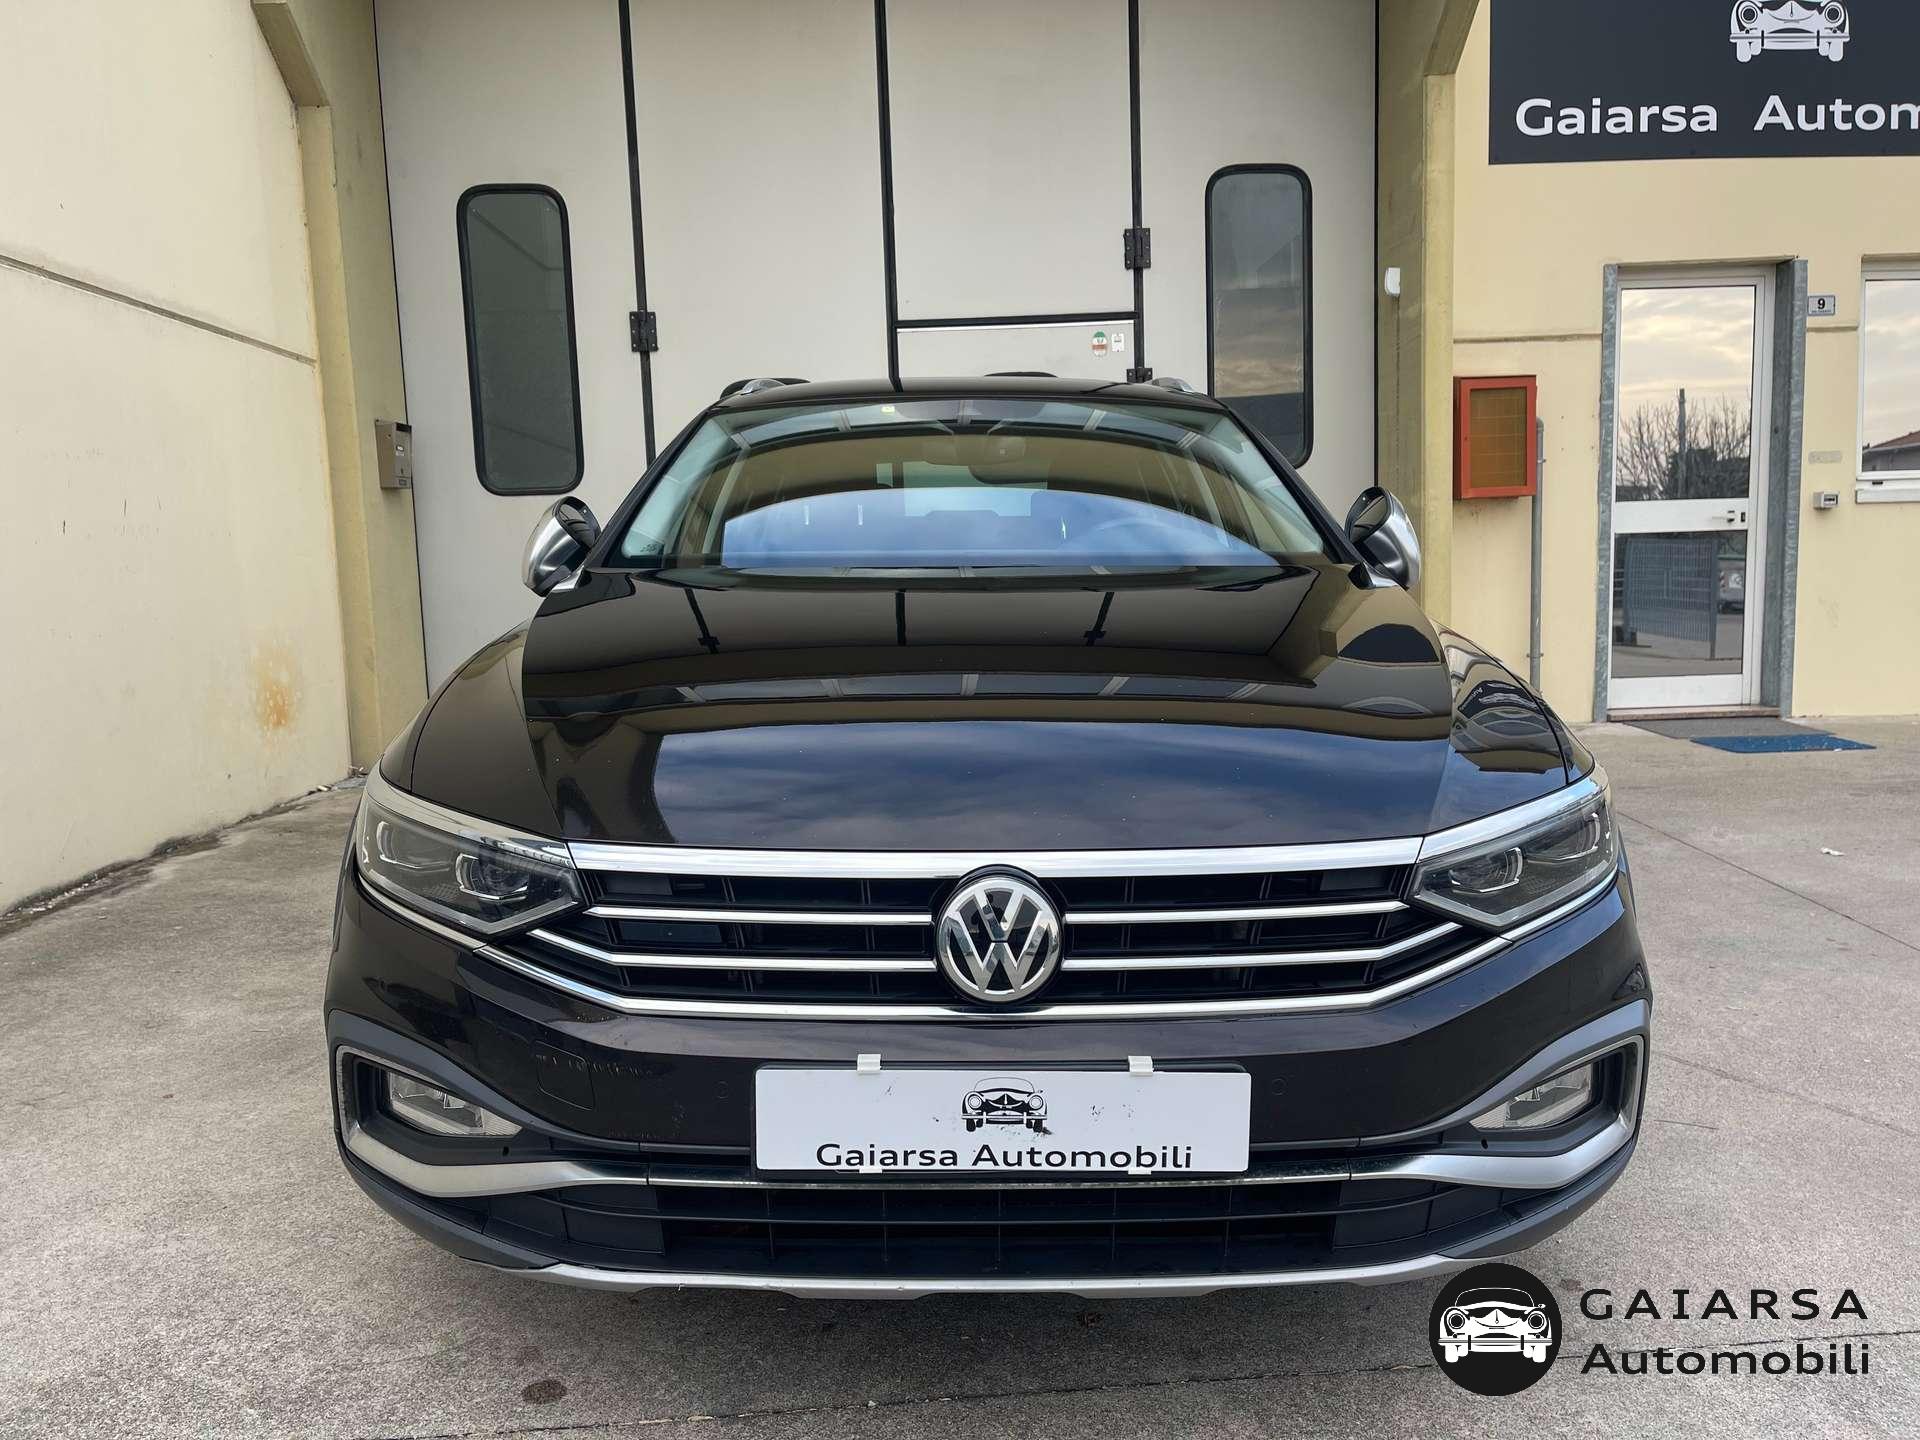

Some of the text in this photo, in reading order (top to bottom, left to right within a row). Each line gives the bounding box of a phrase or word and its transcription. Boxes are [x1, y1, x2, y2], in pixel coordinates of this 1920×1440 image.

[1515, 97, 1718, 137] Gaiarsa
[1817, 297, 1826, 310] 9
[816, 1143, 1192, 1169] Gaiarsa Automobili
